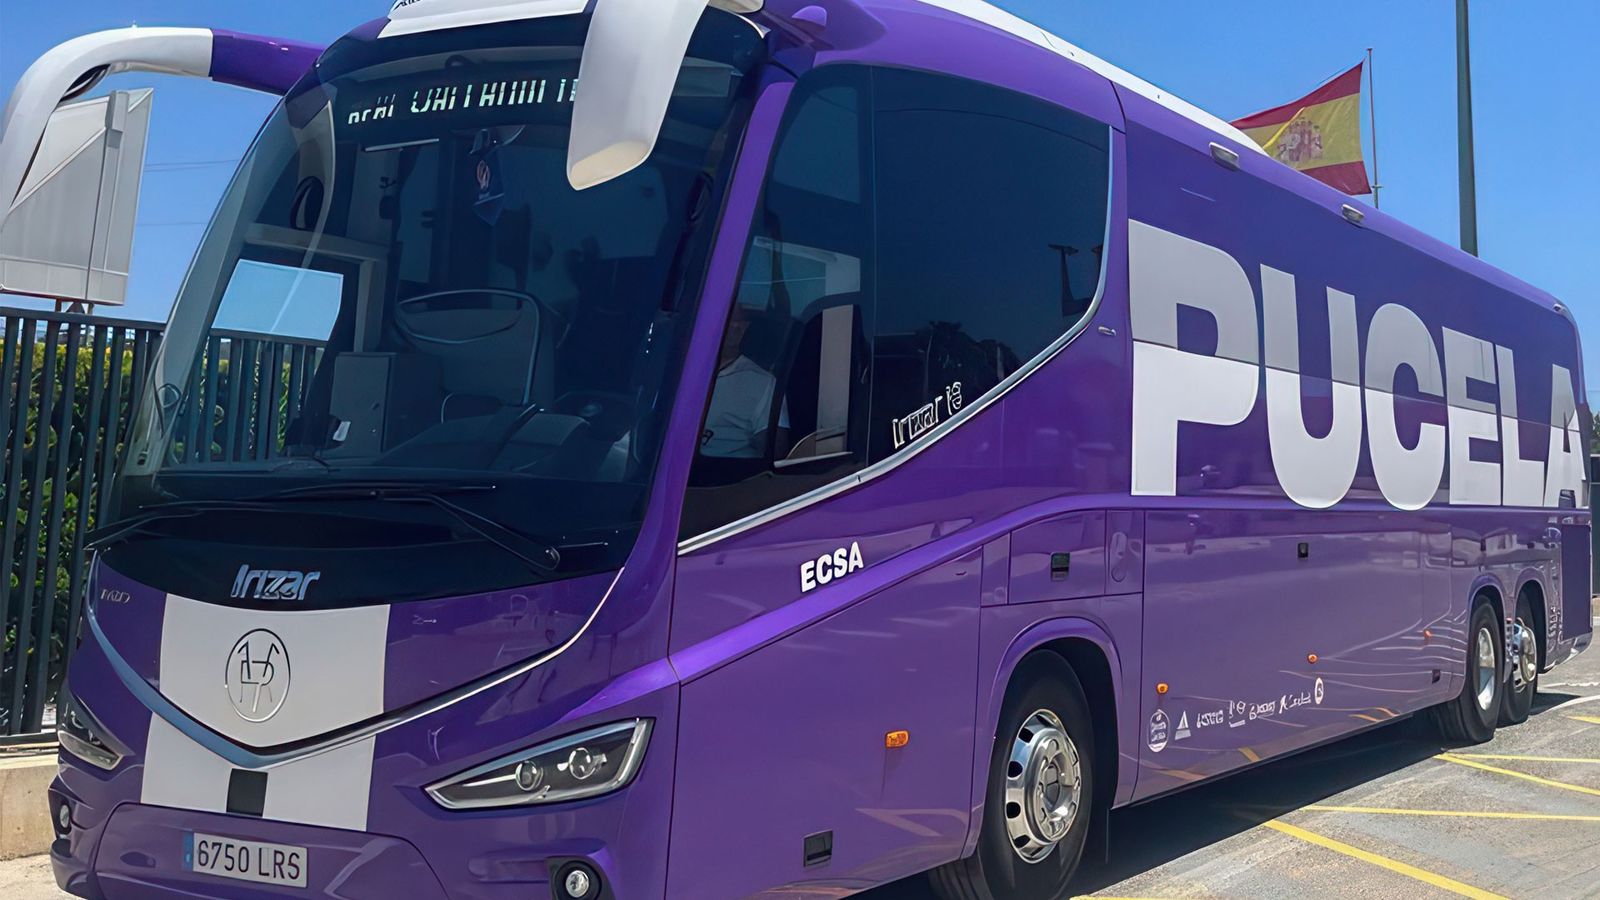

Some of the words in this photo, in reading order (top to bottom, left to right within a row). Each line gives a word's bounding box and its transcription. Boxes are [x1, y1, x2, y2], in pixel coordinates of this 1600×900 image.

[1128, 218, 1588, 511] PUCELA
[230, 564, 321, 601] Irizar
[800, 541, 864, 593] ECSA
[197, 840, 250, 873] 6750
[258, 847, 301, 880] LRS
